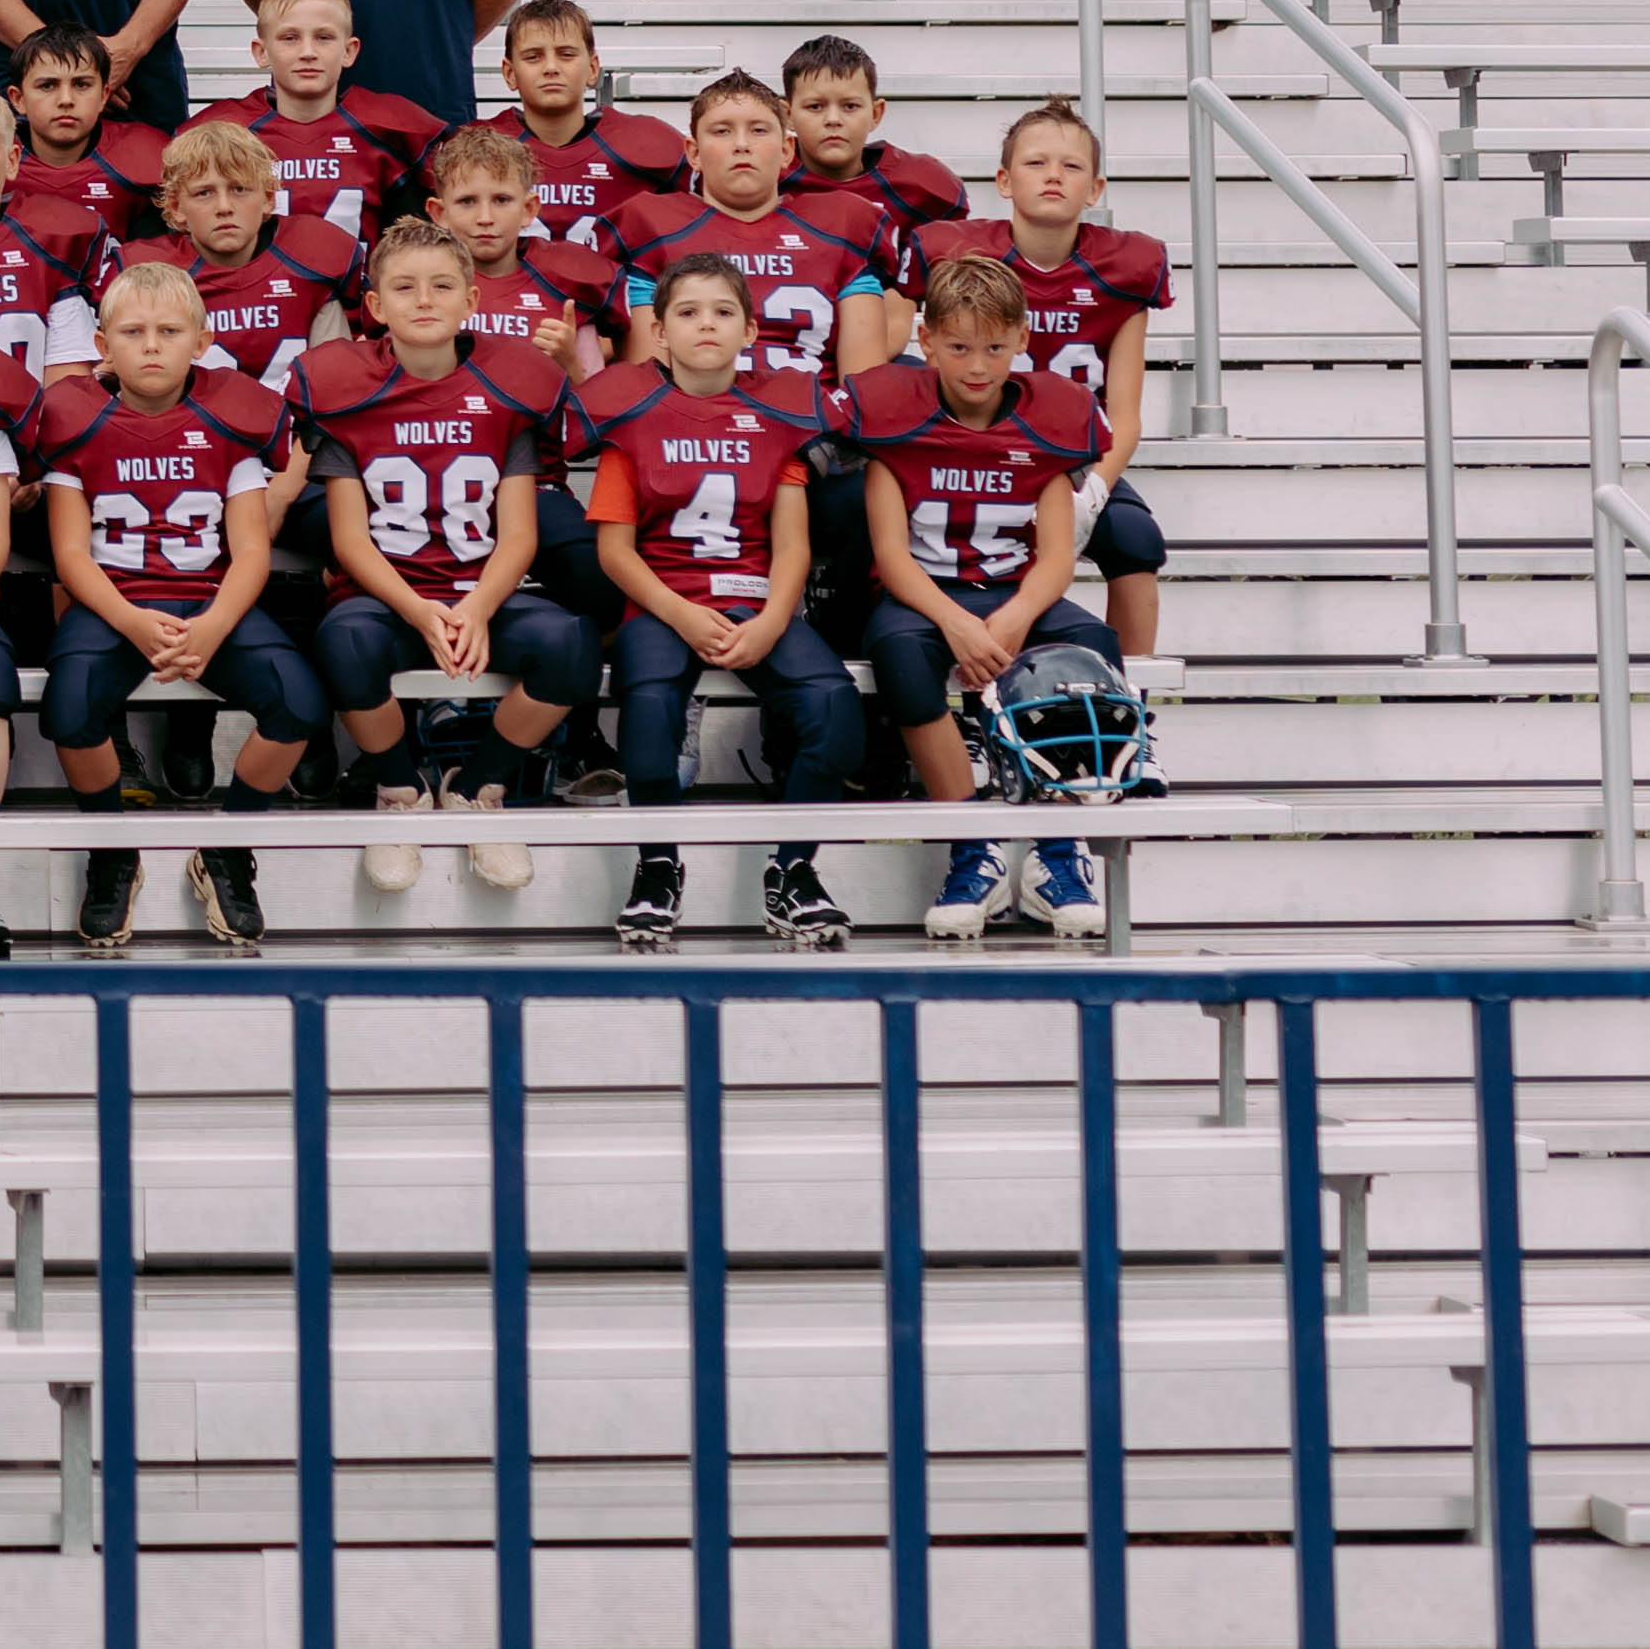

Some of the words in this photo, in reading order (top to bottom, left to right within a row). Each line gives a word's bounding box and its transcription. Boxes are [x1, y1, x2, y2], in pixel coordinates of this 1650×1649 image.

[393, 420, 473, 446] WOLVES
[661, 438, 751, 465] WOLVES
[116, 455, 195, 483] WOLVES
[930, 466, 1013, 494] WOLVES
[362, 454, 501, 563] 88
[669, 473, 741, 559] 4
